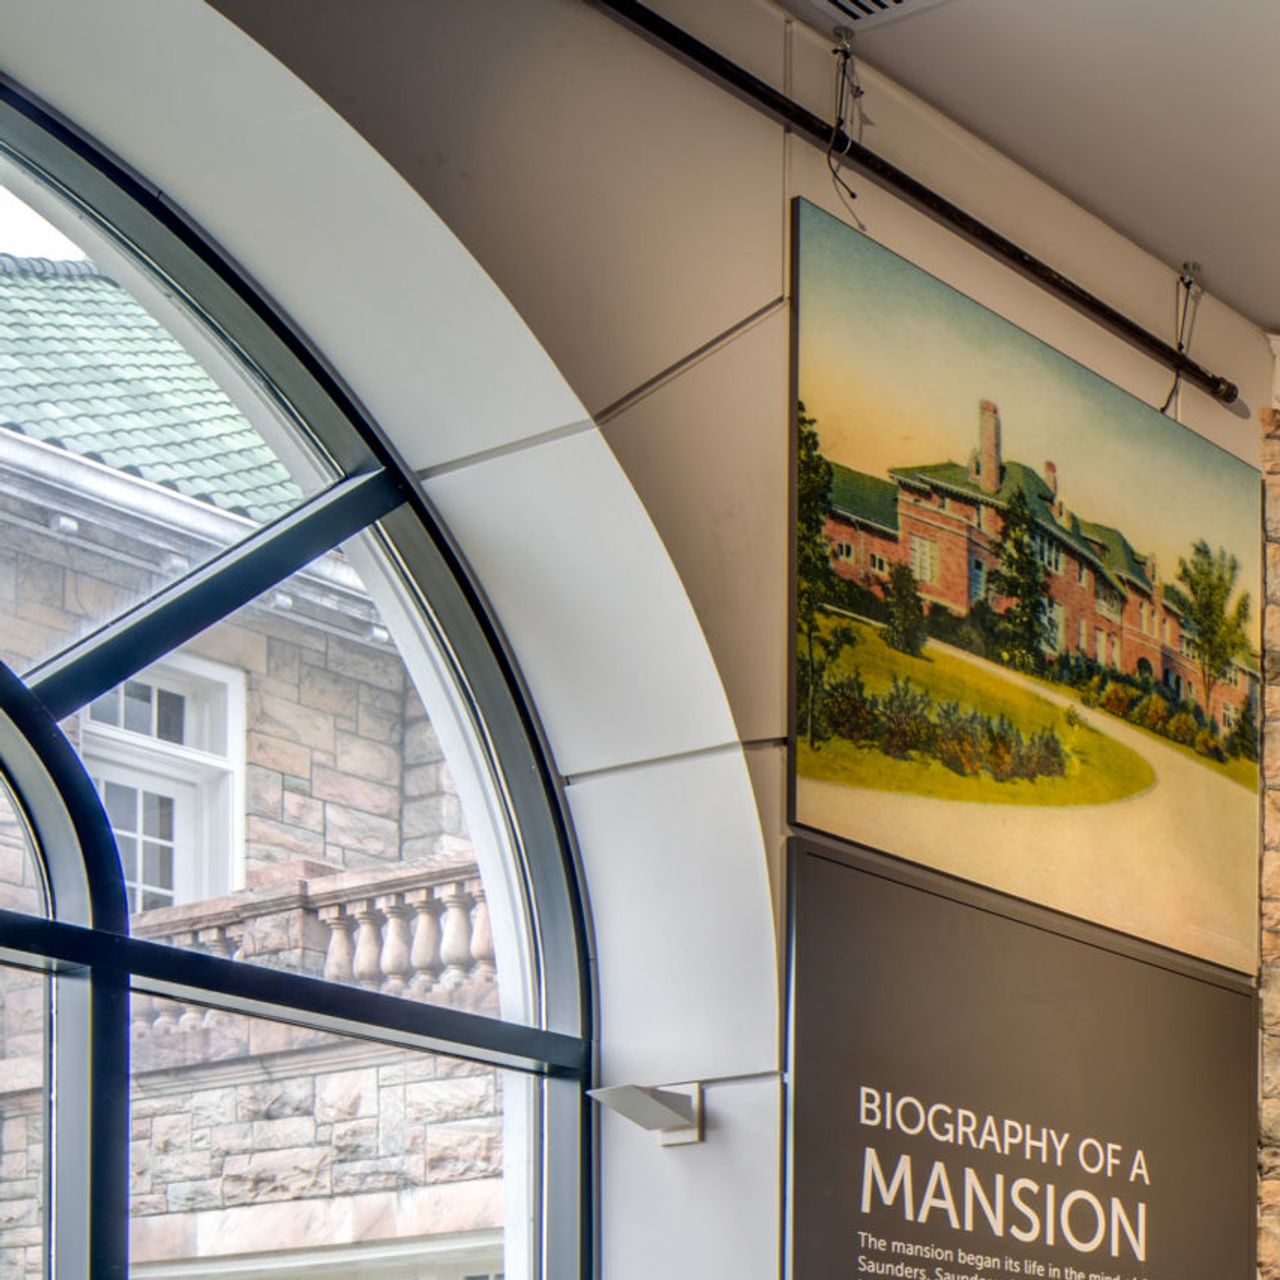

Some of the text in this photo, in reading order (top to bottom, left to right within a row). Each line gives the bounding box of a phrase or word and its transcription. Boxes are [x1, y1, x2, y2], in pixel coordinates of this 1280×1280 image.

[859, 1086, 1151, 1185] BIOGRAPHY OF A
[860, 1147, 1146, 1262] MANSION
[857, 1231, 887, 1251] The
[891, 1241, 953, 1262] mansion
[957, 1248, 1000, 1270] began
[1004, 1255, 1020, 1273] its
[1024, 1259, 1045, 1276] life
[1048, 1262, 1060, 1279] in
[858, 1255, 930, 1280] Saunders.
